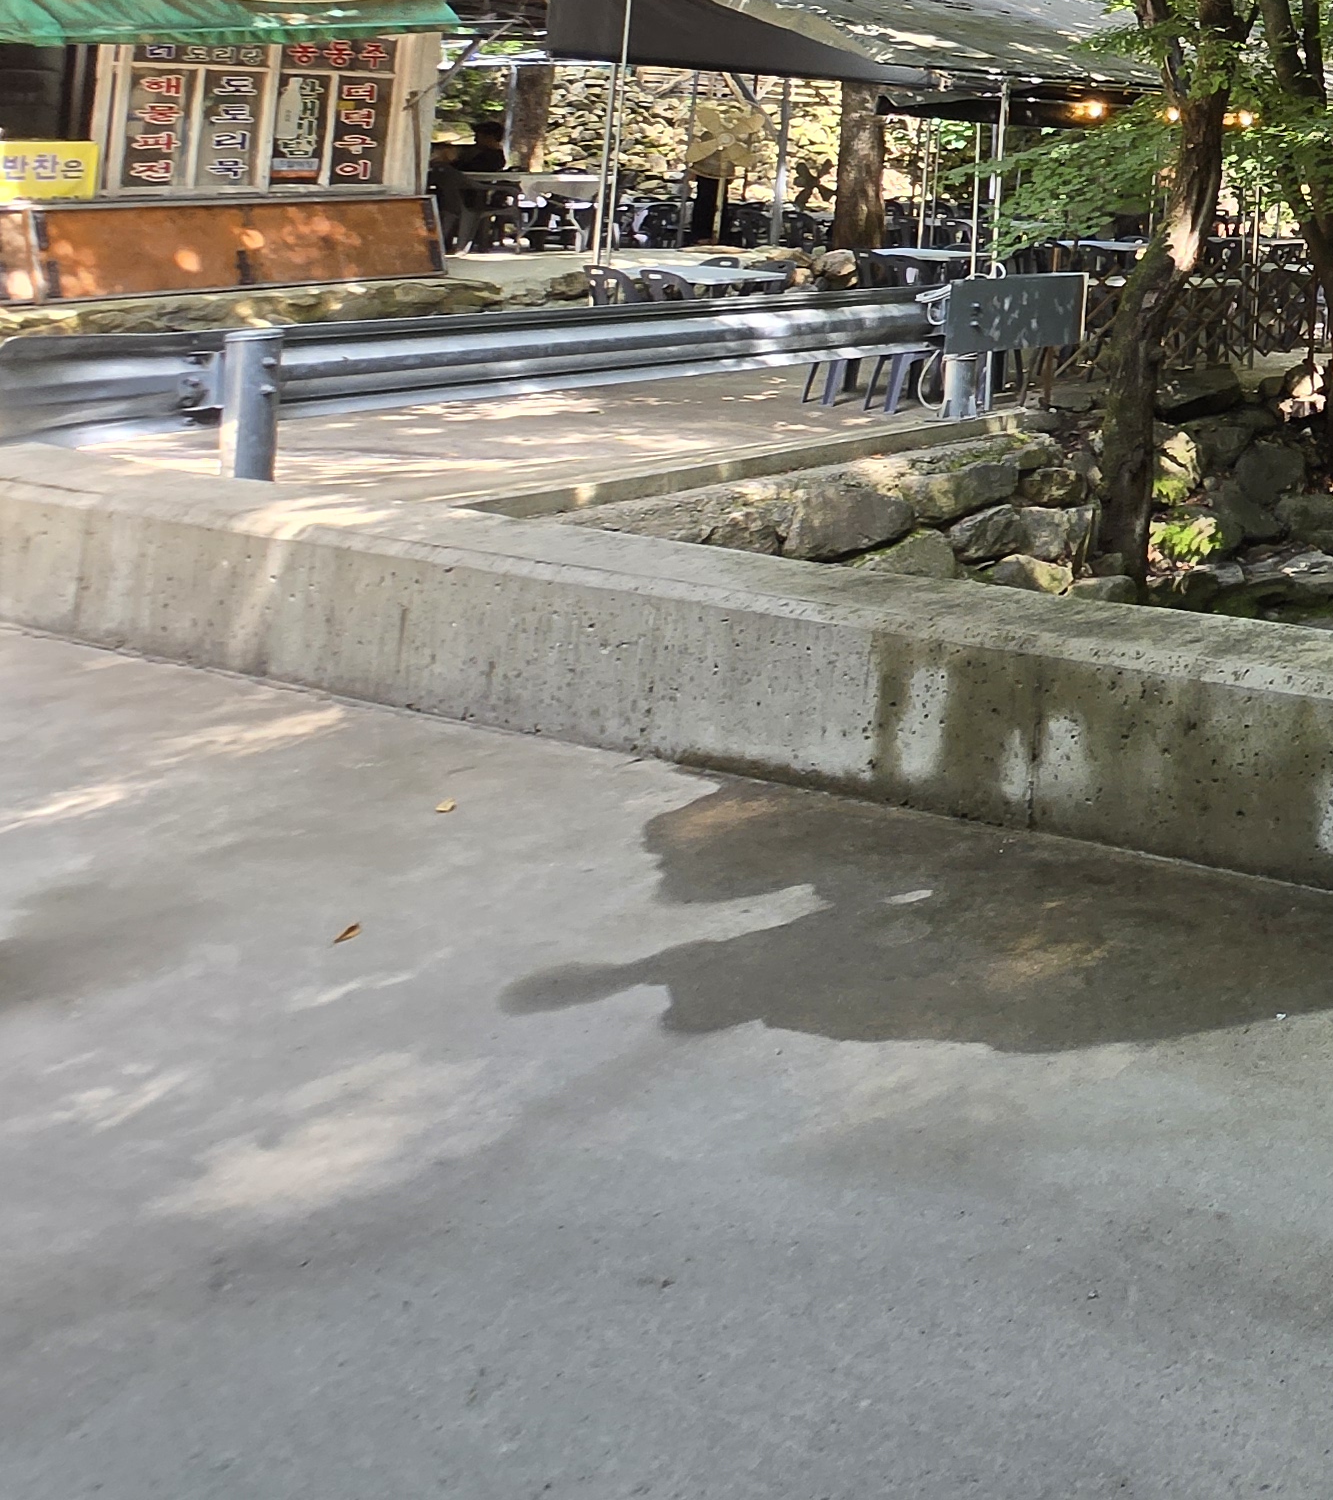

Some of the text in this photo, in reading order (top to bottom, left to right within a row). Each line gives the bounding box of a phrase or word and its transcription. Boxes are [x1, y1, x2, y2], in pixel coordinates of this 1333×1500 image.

[3, 154, 84, 180] 반찬은
[130, 74, 185, 182] 해물파전
[206, 75, 258, 179] 도토리묵
[334, 83, 378, 180] 더덕구이
